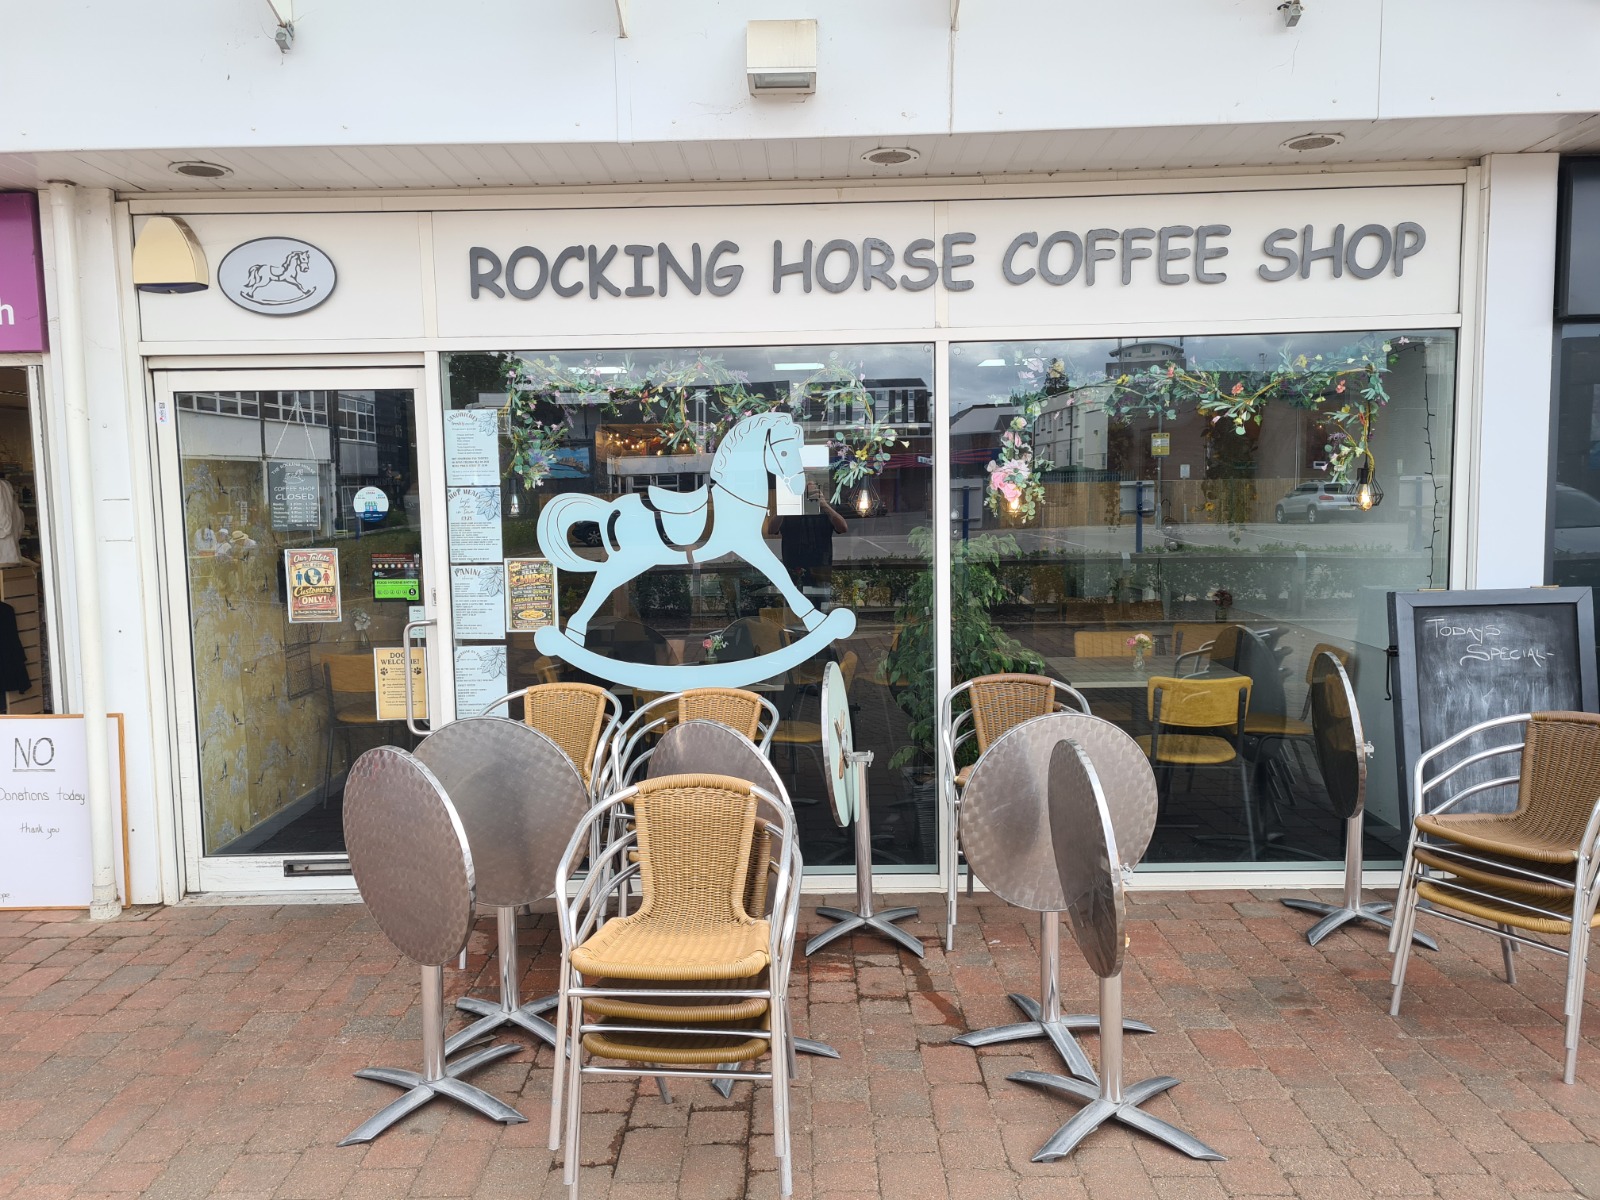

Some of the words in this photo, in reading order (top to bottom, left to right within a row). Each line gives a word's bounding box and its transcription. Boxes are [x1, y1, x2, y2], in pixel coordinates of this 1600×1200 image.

[468, 240, 745, 301] ROCKING
[772, 232, 977, 293] HORSE
[1002, 224, 1232, 286] COFFEE
[1258, 221, 1426, 282] SHOP
[275, 493, 315, 501] CLOSED
[293, 555, 307, 563] Our
[307, 553, 330, 562] Toilets
[454, 567, 481, 577] PANINI
[512, 573, 551, 585] CHIPS!
[294, 586, 334, 597] Customers
[302, 596, 327, 605] ONLY!
[14, 737, 55, 768] NO
[0, 787, 50, 801] Donations
[56, 787, 86, 806] today
[20, 822, 44, 834] thank
[47, 827, 60, 840] you
